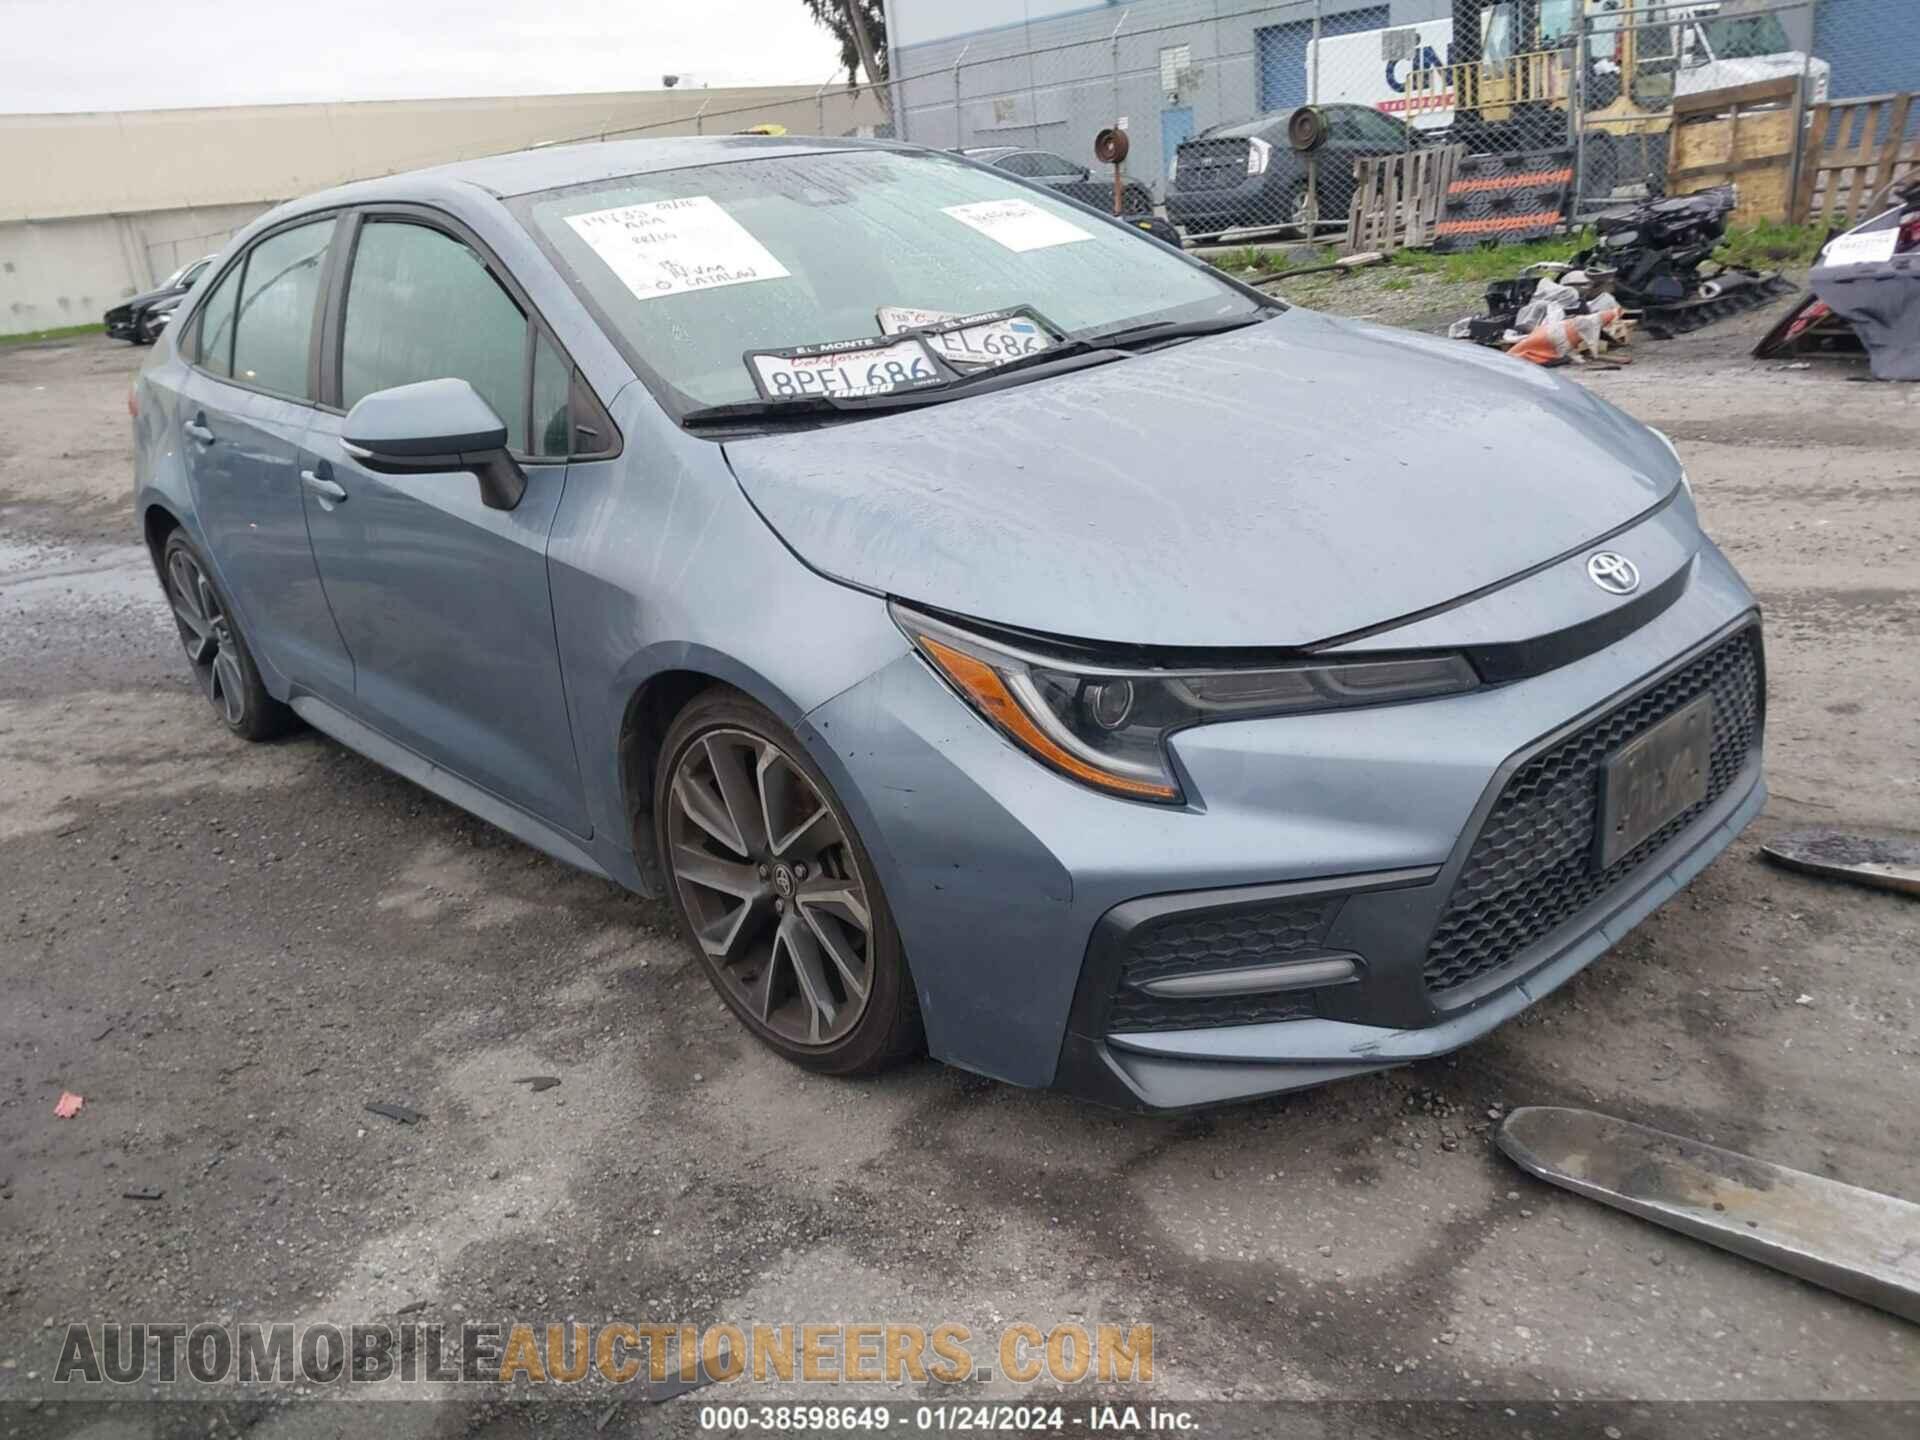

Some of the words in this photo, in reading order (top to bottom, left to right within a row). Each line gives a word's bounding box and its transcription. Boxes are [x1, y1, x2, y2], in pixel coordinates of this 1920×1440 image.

[961, 312, 1001, 325] MONTE
[796, 346, 817, 354] EL
[820, 338, 875, 352] MONTE
[942, 329, 1040, 357] EL686
[790, 350, 894, 368] California
